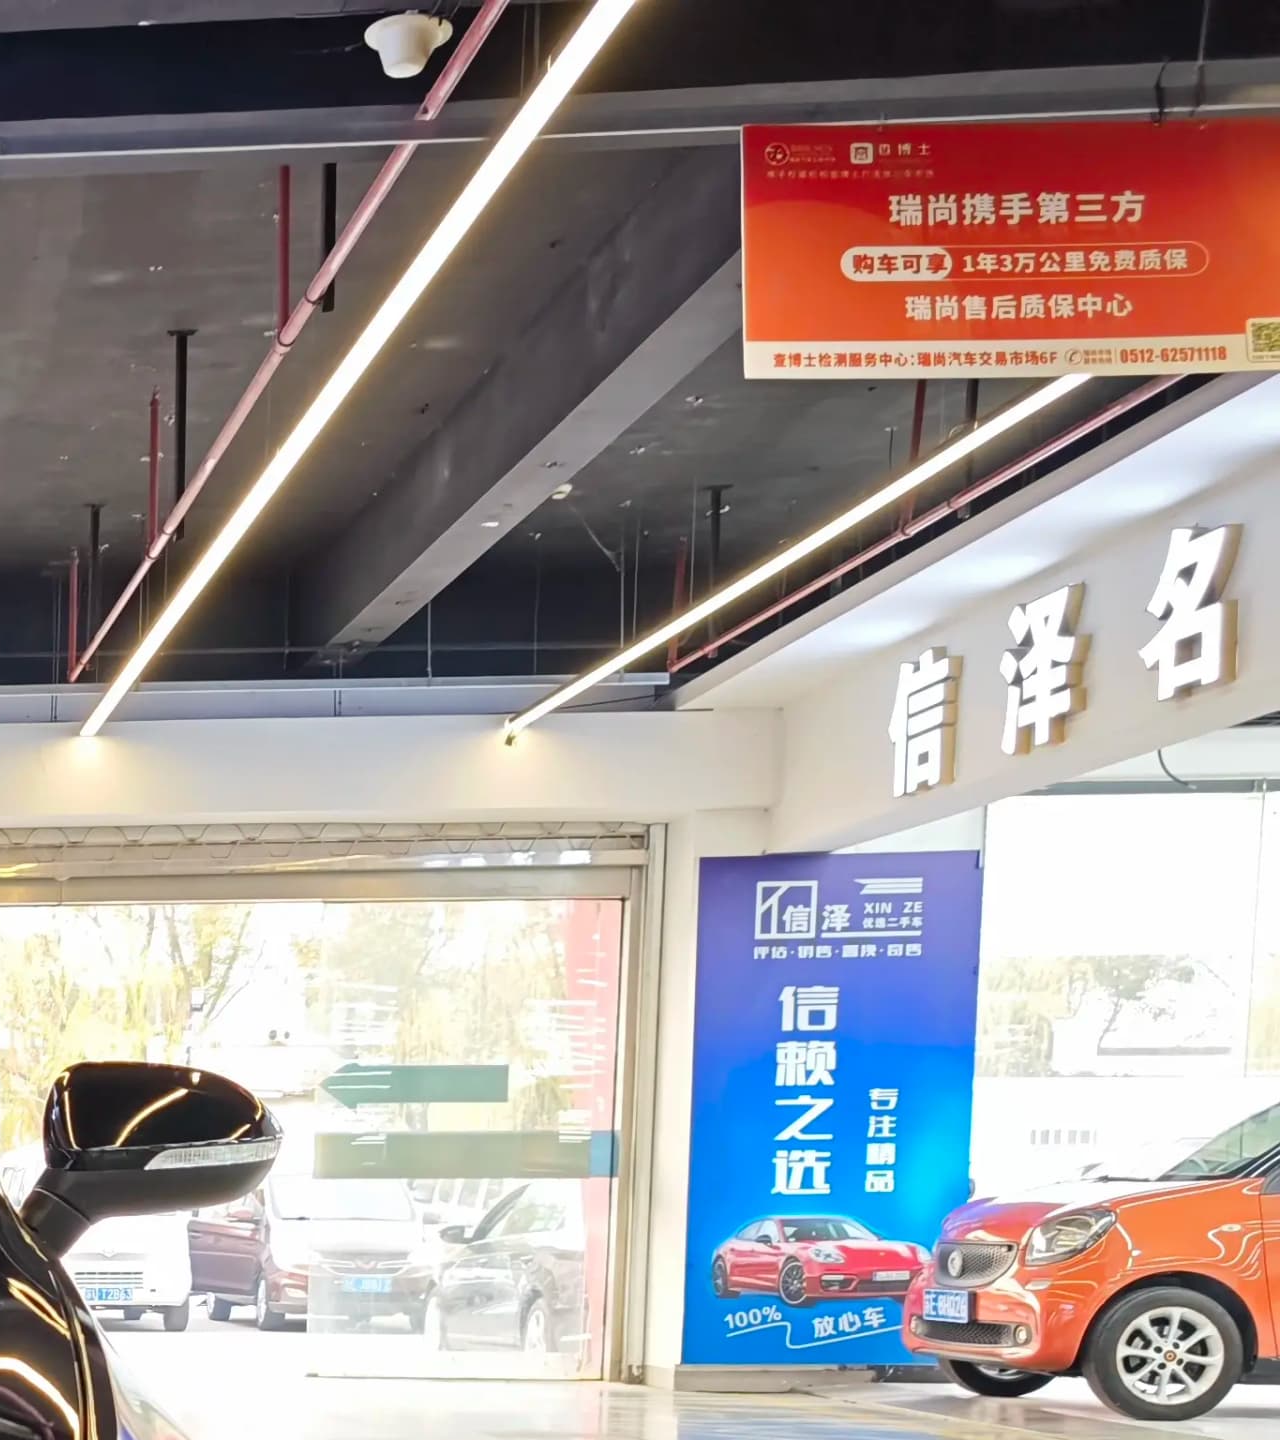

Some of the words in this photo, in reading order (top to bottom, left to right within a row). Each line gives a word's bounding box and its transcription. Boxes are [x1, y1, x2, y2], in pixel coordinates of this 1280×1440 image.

[888, 190, 1146, 226] 瑞尚携手第三方
[852, 254, 948, 274] 购车可享
[962, 247, 1188, 274] 1年3万公里免费质保
[904, 293, 1134, 321] 瑞尚售后质保中心
[888, 524, 1242, 798] 信泽名
[863, 902, 893, 915] XIN
[903, 901, 924, 914] ZE
[770, 985, 840, 1195] 信赖之选
[723, 1304, 783, 1330] 100%
[811, 1306, 887, 1338] 放心车
